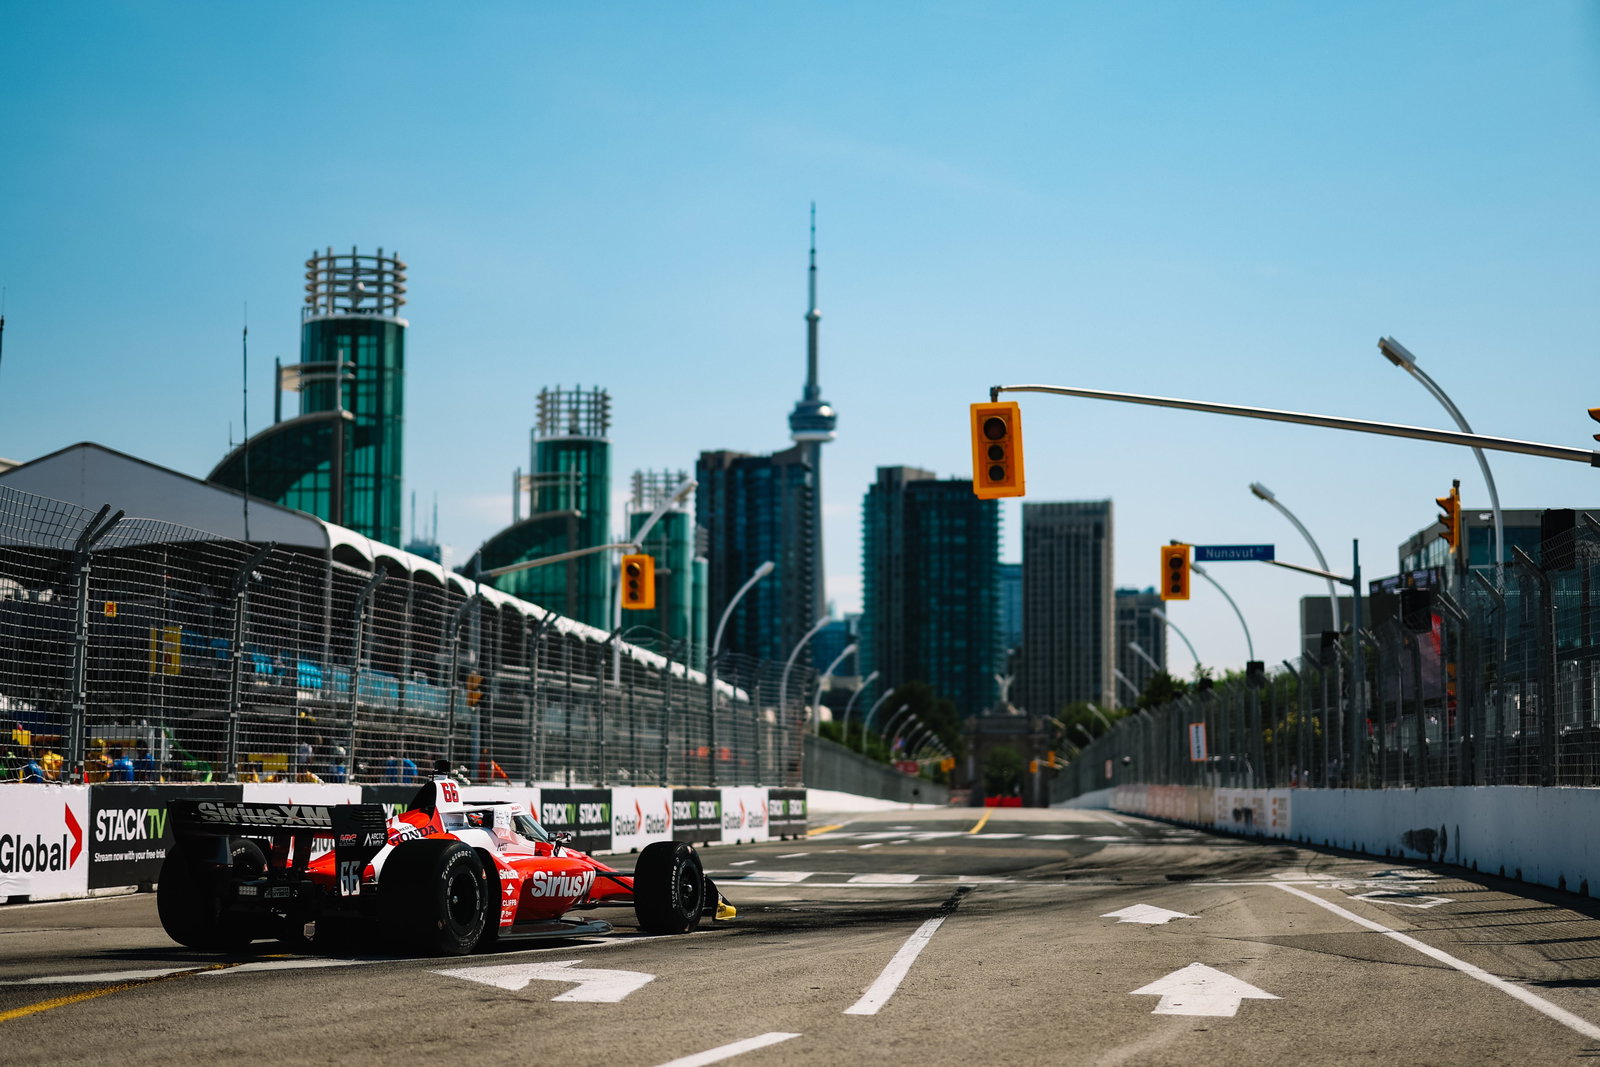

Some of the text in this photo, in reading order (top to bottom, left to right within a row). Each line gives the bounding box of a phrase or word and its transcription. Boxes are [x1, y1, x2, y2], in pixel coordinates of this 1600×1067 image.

[1205, 548, 1254, 558] Nunavut
[440, 782, 459, 803] 66
[95, 808, 167, 842] STACKTV
[198, 802, 333, 827] SiriusXM
[542, 802, 576, 825] STACKTV
[579, 802, 610, 825] STACKTV
[390, 825, 438, 844] HONDA
[616, 815, 636, 836] Global
[0, 833, 67, 873] Global
[94, 852, 113, 863] Stream
[113, 853, 124, 861] now
[124, 850, 135, 860] with
[134, 852, 146, 863] your
[146, 849, 156, 859] free
[340, 860, 360, 897] 66
